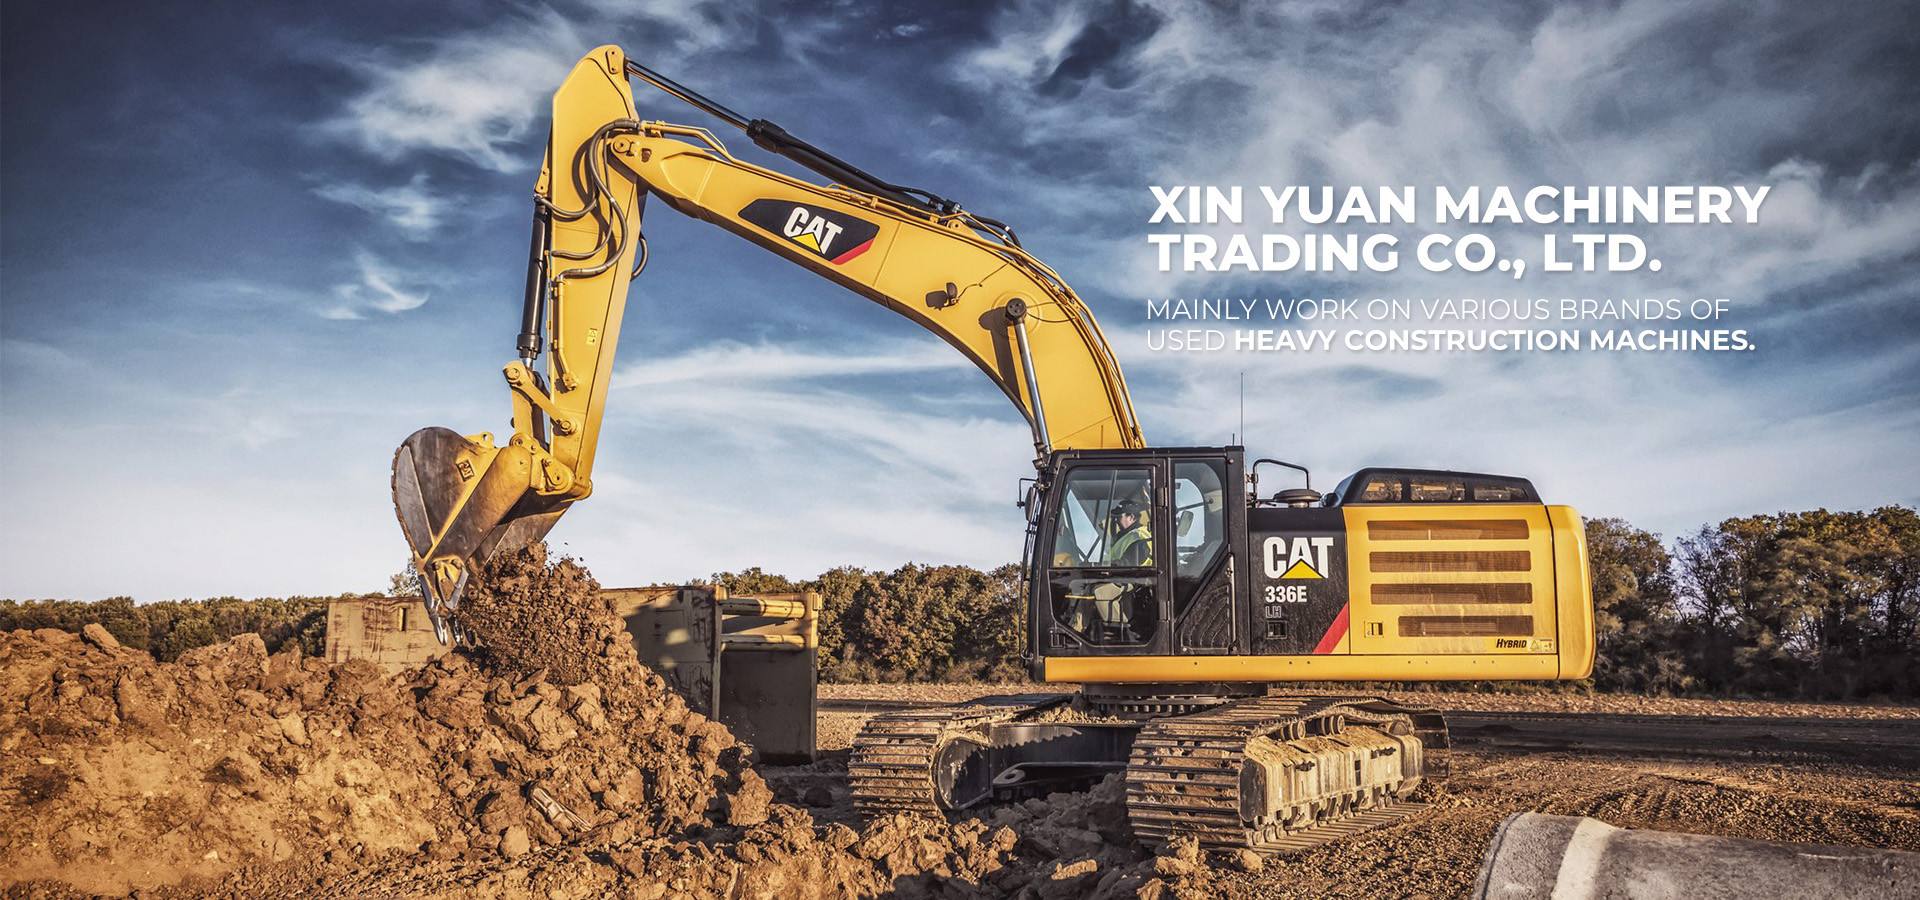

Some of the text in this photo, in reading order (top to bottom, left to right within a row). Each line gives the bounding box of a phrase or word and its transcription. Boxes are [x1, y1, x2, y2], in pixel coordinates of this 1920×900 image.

[783, 206, 844, 255] CAT
[1263, 537, 1334, 579] CAT
[1265, 585, 1308, 603] 336E
[1265, 605, 1282, 619] LH
